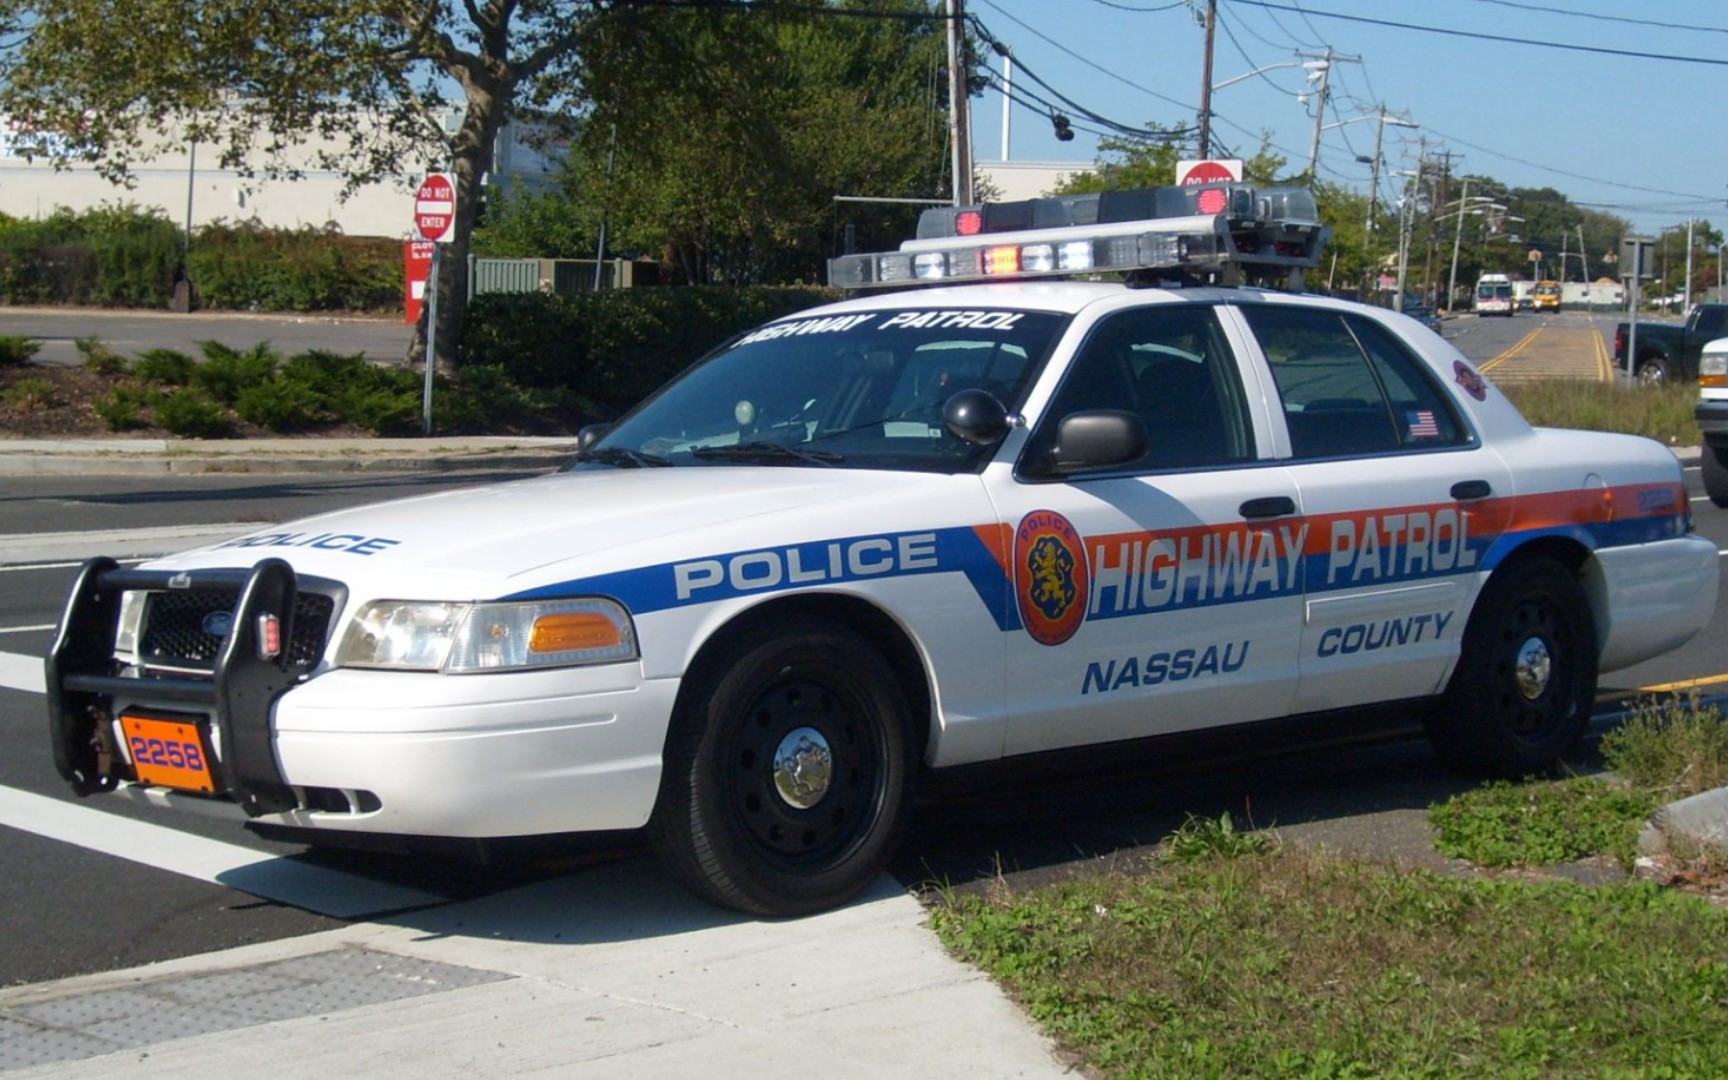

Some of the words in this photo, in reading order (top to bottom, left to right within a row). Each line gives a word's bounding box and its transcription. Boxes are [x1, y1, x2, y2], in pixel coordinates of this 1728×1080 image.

[421, 188, 432, 198] DO
[435, 188, 450, 199] NOT
[421, 216, 445, 228] ENTER
[730, 313, 877, 349] HIGHWAY
[878, 311, 1024, 330] PATROL
[209, 532, 402, 556] POLICE
[1021, 515, 1072, 542] POLICE
[673, 532, 938, 600] POLICE
[1090, 523, 1310, 615] HIGHWAY
[1328, 509, 1477, 583] PATROL
[1081, 640, 1251, 695] NASSAU
[1317, 610, 1455, 658] COUNTY
[130, 736, 204, 772] 2258
